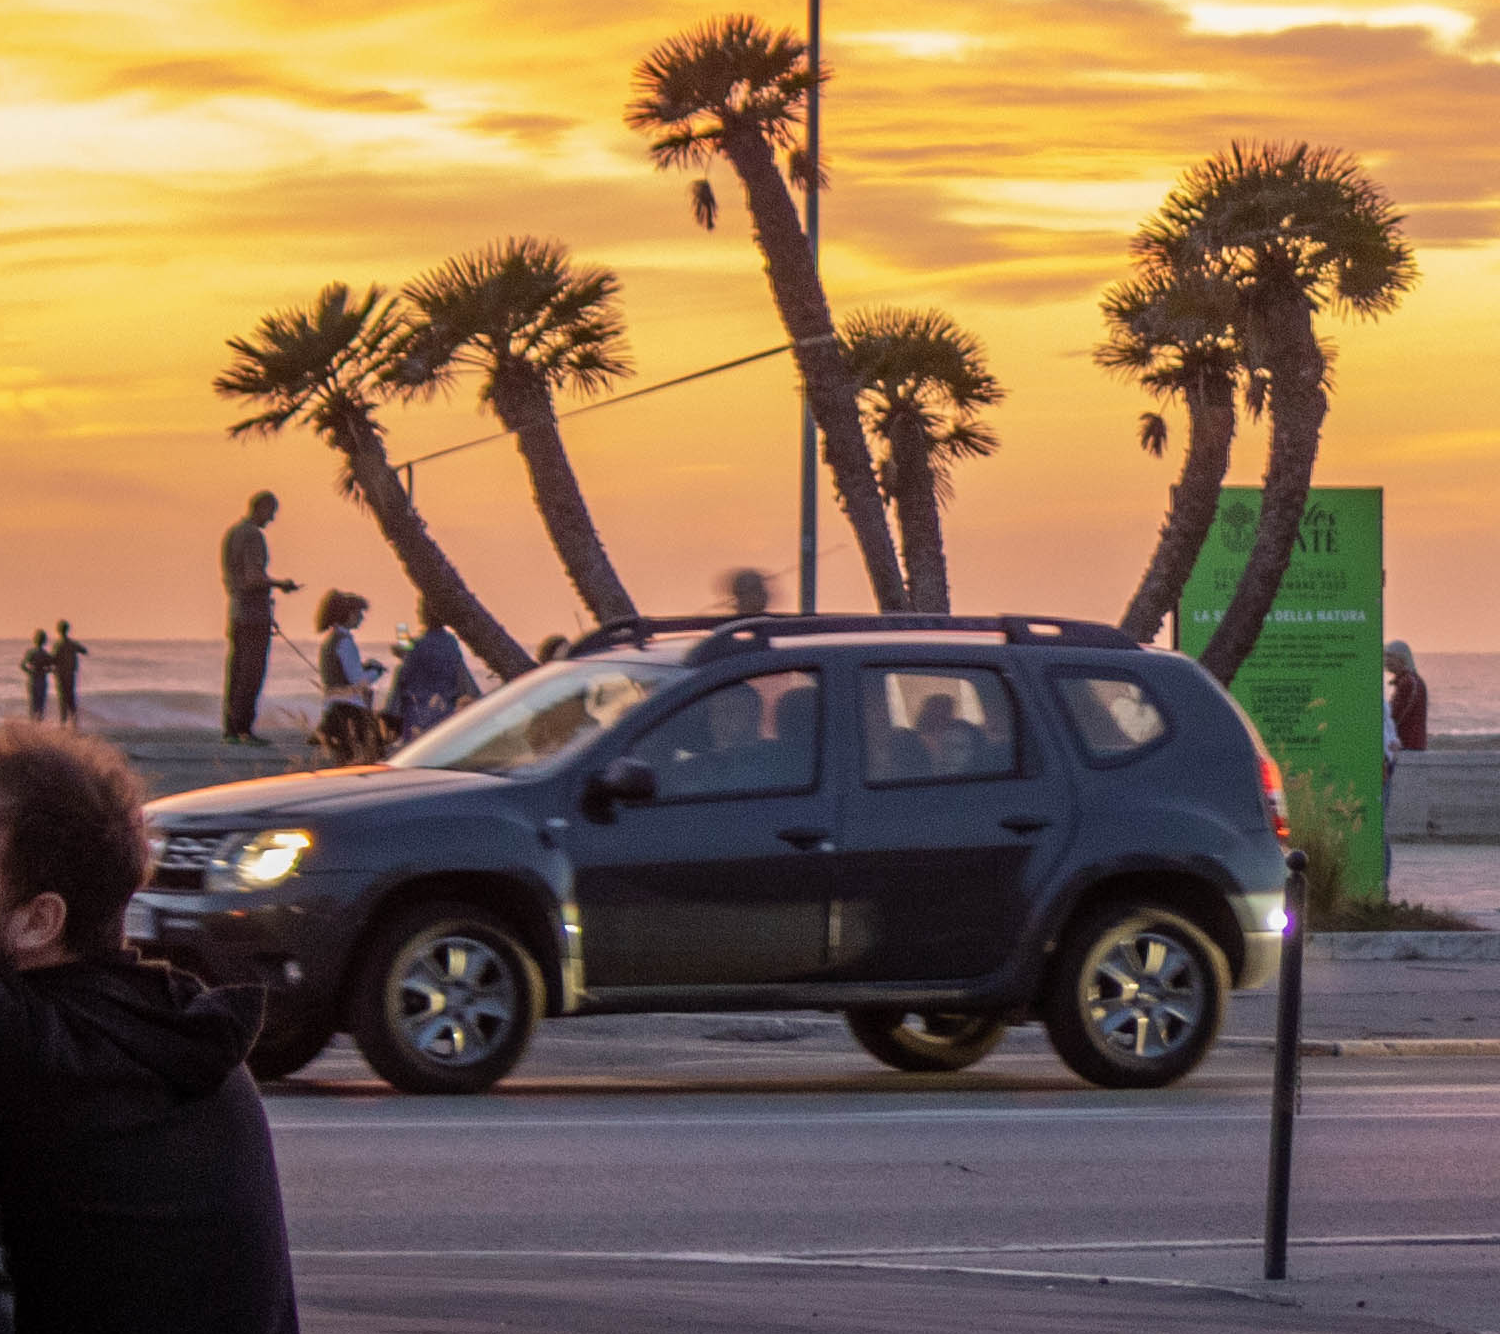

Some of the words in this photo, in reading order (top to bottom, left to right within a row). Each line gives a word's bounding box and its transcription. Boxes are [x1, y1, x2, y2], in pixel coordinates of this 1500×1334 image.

[1193, 610, 1210, 622] LA
[1274, 610, 1313, 622] DELLA
[1316, 609, 1367, 622] NATURA
